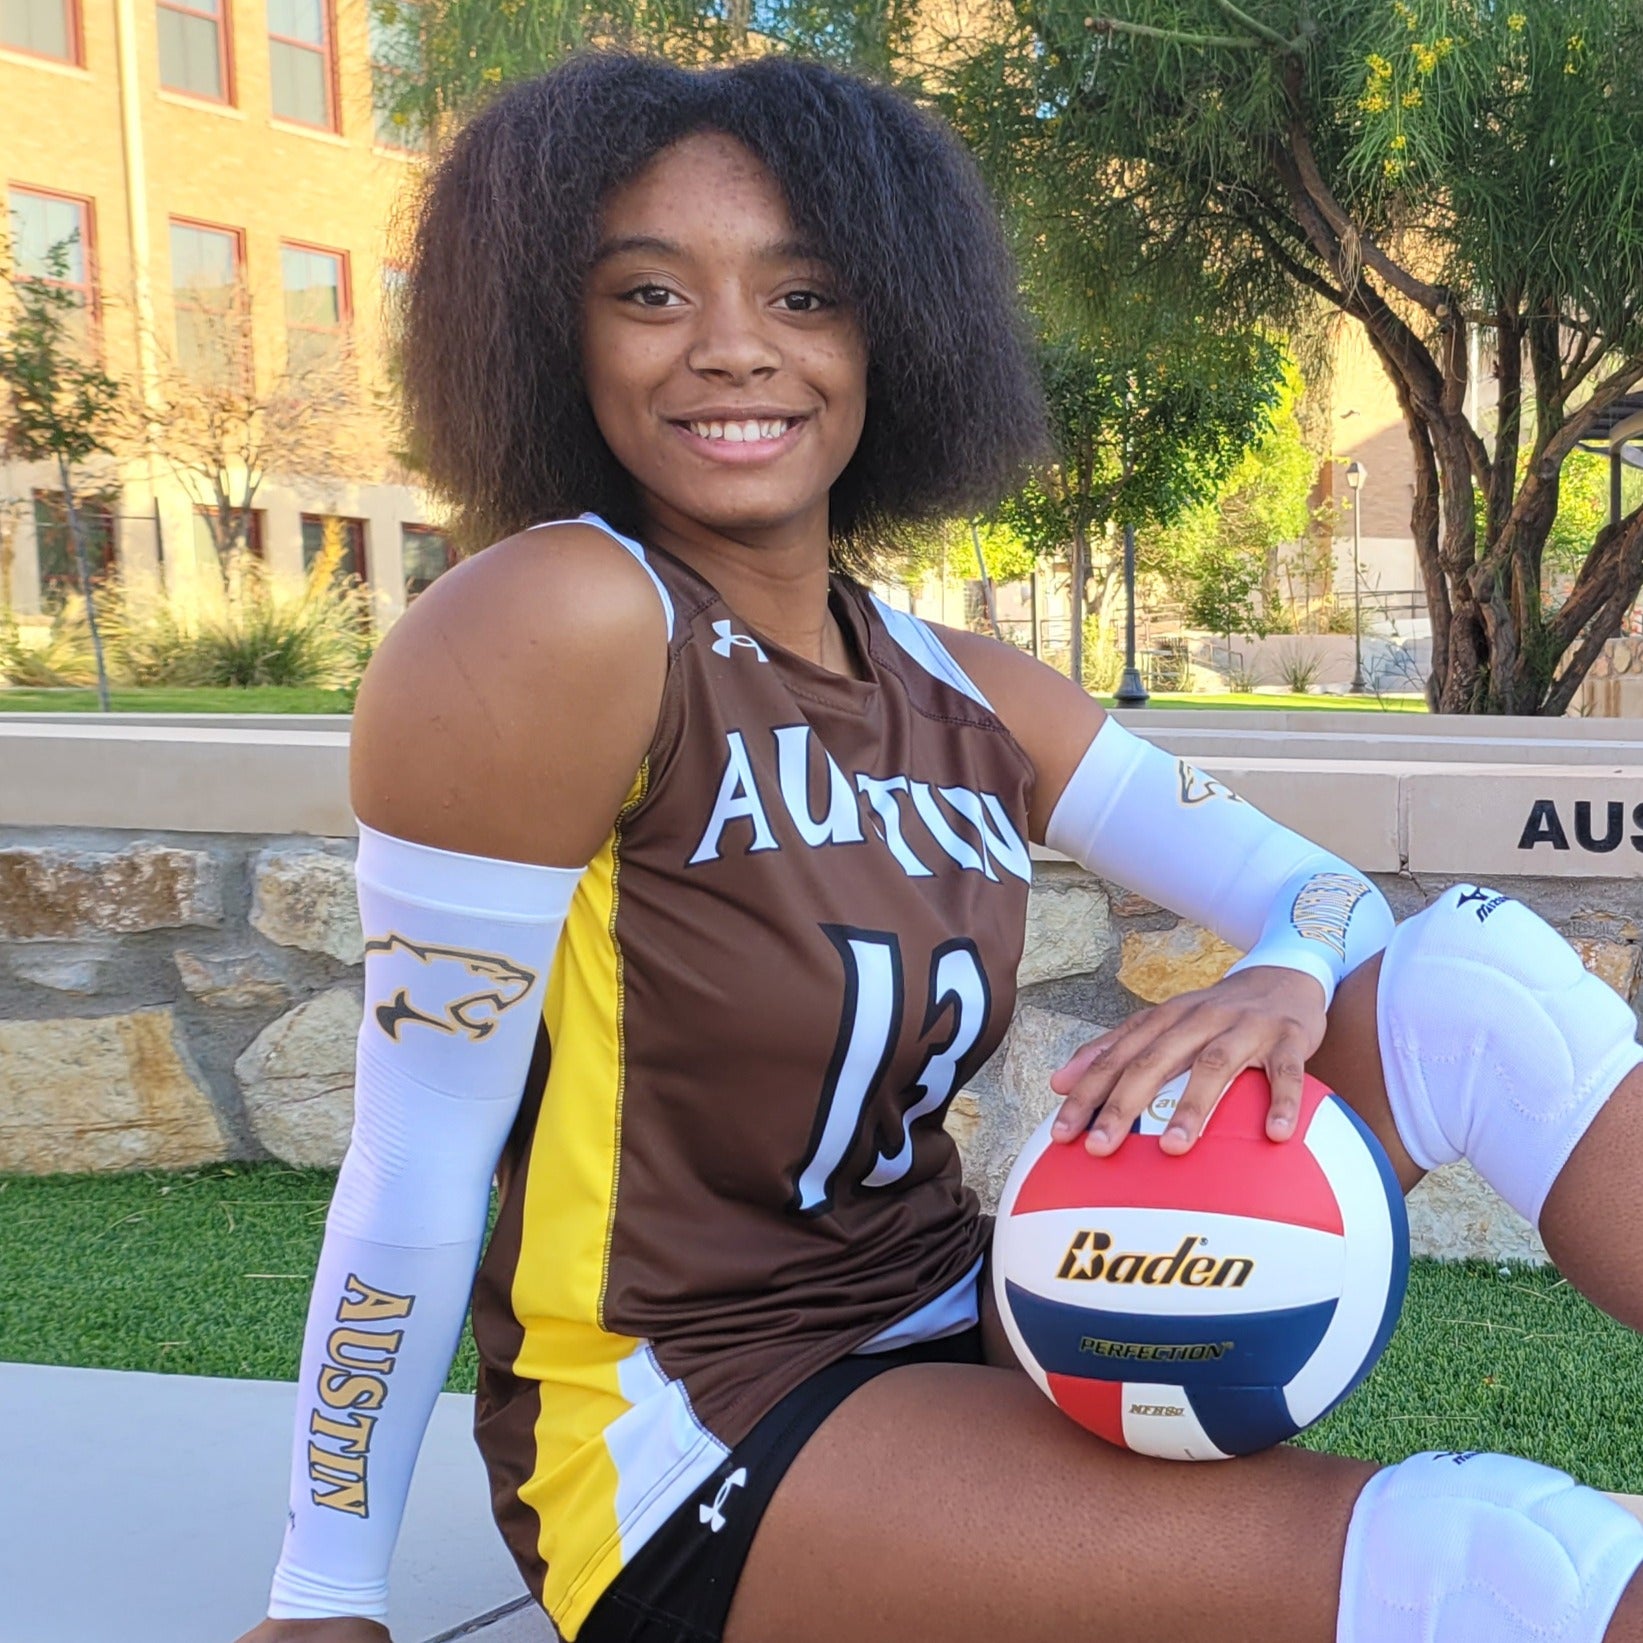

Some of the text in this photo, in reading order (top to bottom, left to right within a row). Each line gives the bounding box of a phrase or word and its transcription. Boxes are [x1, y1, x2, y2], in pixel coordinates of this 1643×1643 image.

[1517, 799, 1643, 853] AU
[792, 922, 991, 1216] 13
[1055, 1229, 1257, 1290] Baden
[1079, 1335, 1235, 1363] PERFECTION
[308, 1273, 416, 1518] AUSTIN
